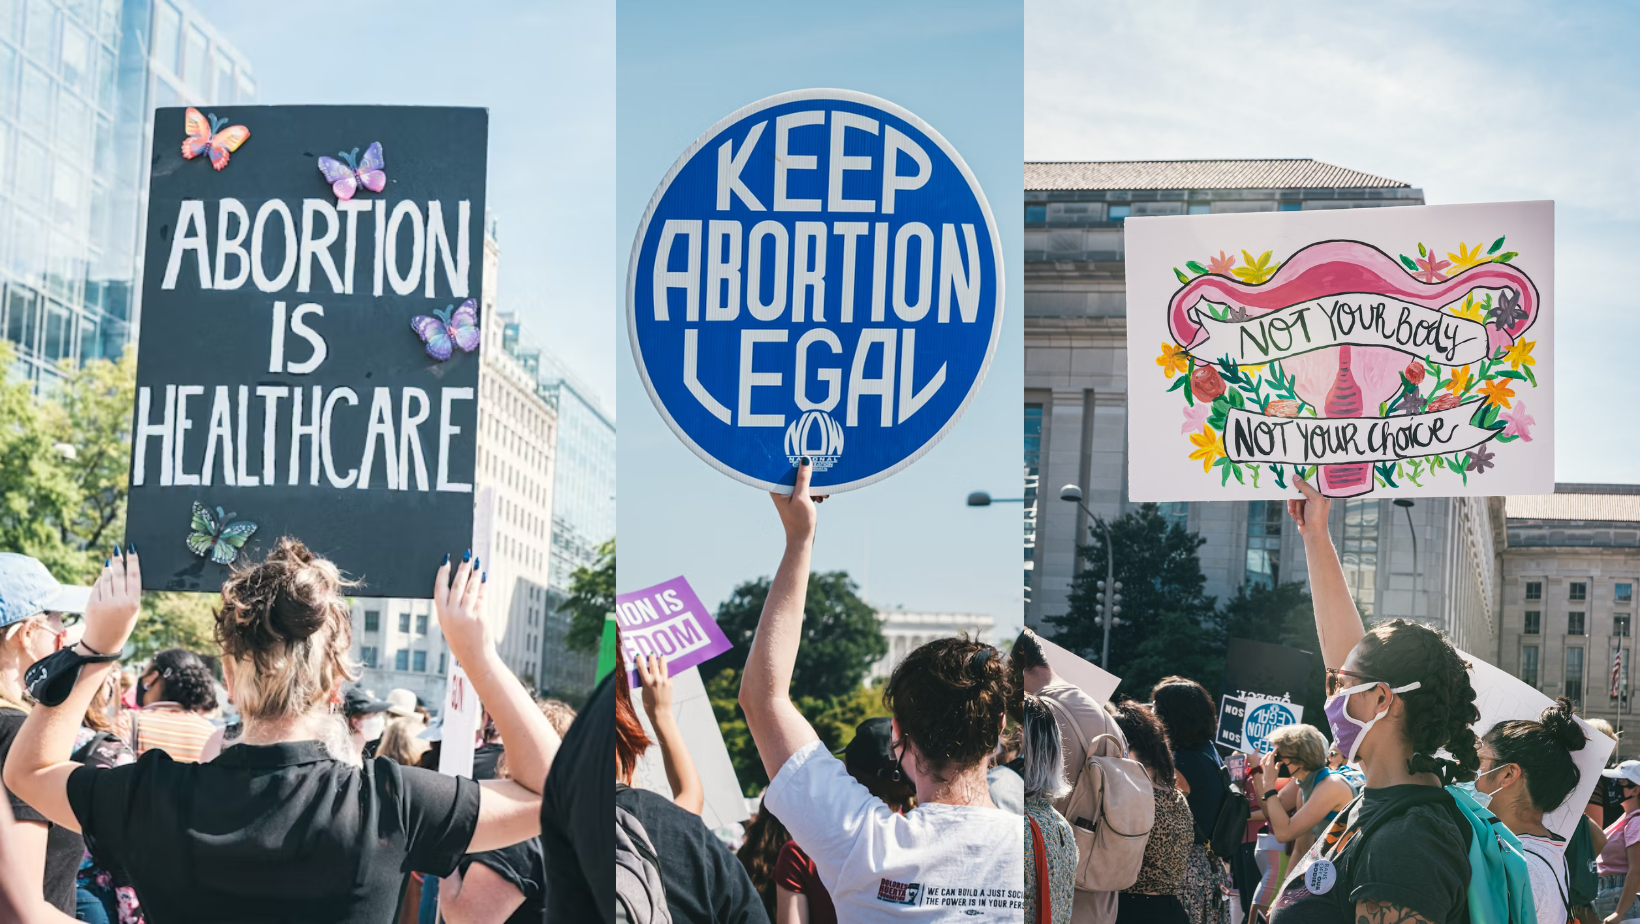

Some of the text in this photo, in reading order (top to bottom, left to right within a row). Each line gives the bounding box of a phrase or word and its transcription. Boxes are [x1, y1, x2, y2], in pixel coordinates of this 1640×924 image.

[716, 110, 933, 214] KEEP
[161, 197, 471, 298] ABORTION
[652, 219, 982, 324] ABORTION
[268, 301, 328, 374] IS
[1240, 307, 1311, 360] NOT
[1317, 300, 1396, 346] YOUR
[683, 327, 947, 428] LEGAL
[132, 384, 474, 492] HEALTHCARE
[784, 411, 845, 456] NOW
[1235, 419, 1294, 458] NOT
[1297, 422, 1365, 462] YOUR
[654, 589, 684, 616] IS
[926, 897, 939, 906] THE
[941, 897, 967, 907] POWER
[968, 898, 976, 906] IS
[978, 898, 986, 907] IN
[989, 899, 1007, 908] YOUR
[927, 887, 939, 896] WE
[941, 888, 955, 896] CAN
[958, 888, 978, 897] BUILD
[979, 888, 985, 897] A
[987, 889, 1005, 898] JUST
